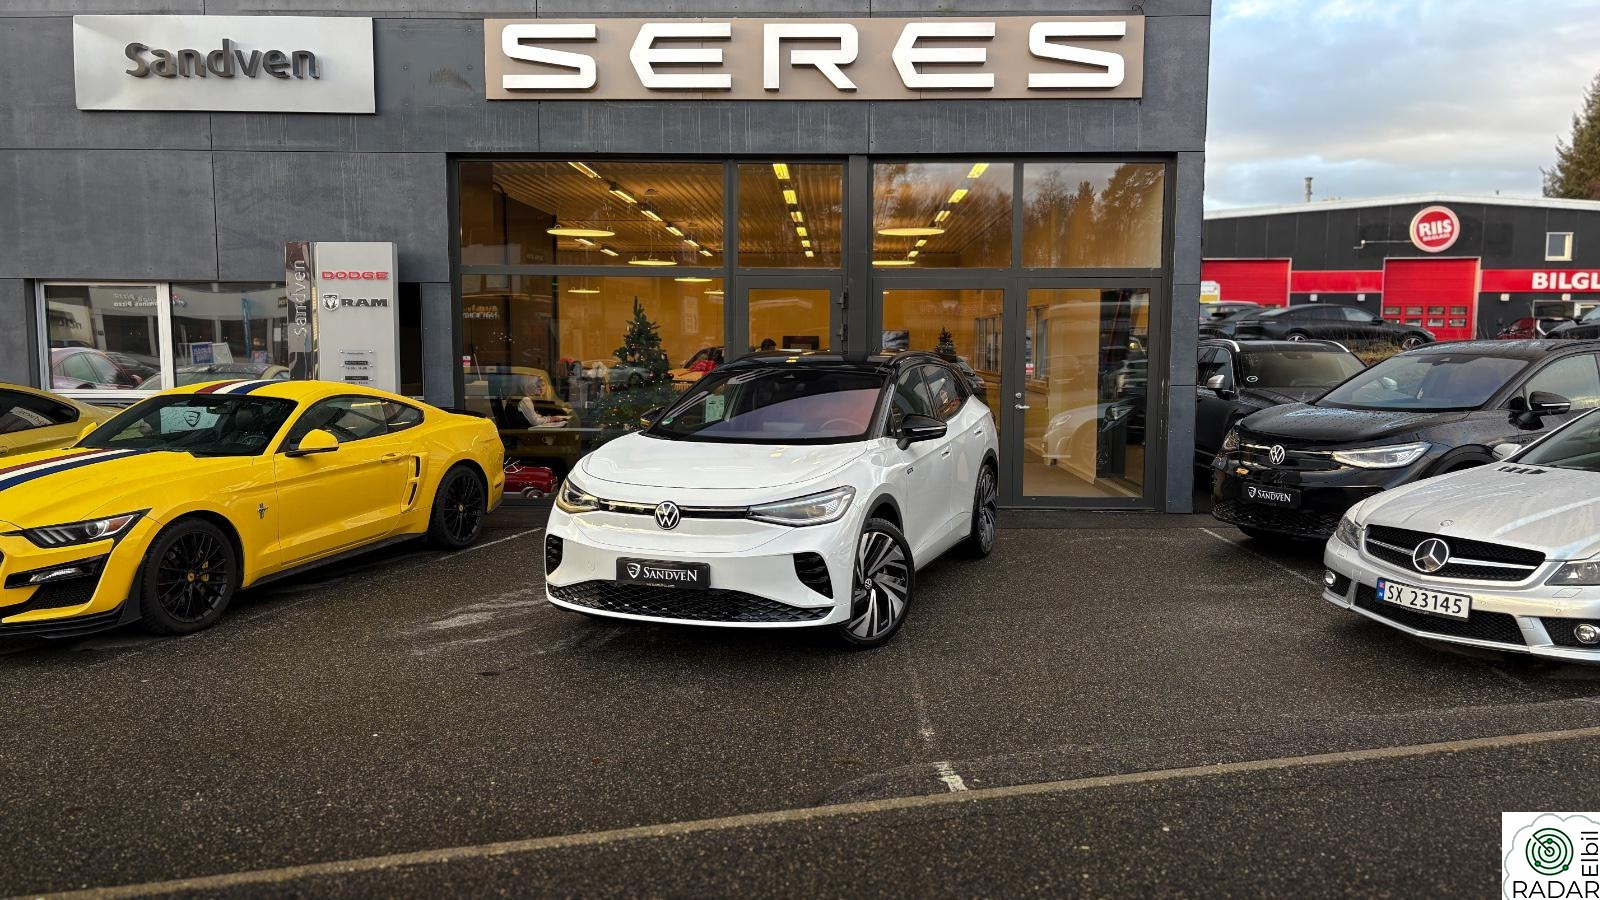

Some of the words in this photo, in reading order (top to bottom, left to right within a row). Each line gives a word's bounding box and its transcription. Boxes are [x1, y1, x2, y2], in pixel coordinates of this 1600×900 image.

[125, 38, 320, 79] Sandven
[502, 21, 1126, 91] SERES
[1419, 219, 1452, 237] RIIS
[322, 271, 389, 280] DODGE
[292, 260, 307, 337] Sandven
[341, 298, 388, 307] RAM
[1257, 489, 1291, 502] SANDVEN
[643, 566, 698, 582] SANDVEN
[1387, 585, 1403, 603] SX
[1409, 590, 1463, 614] 23145
